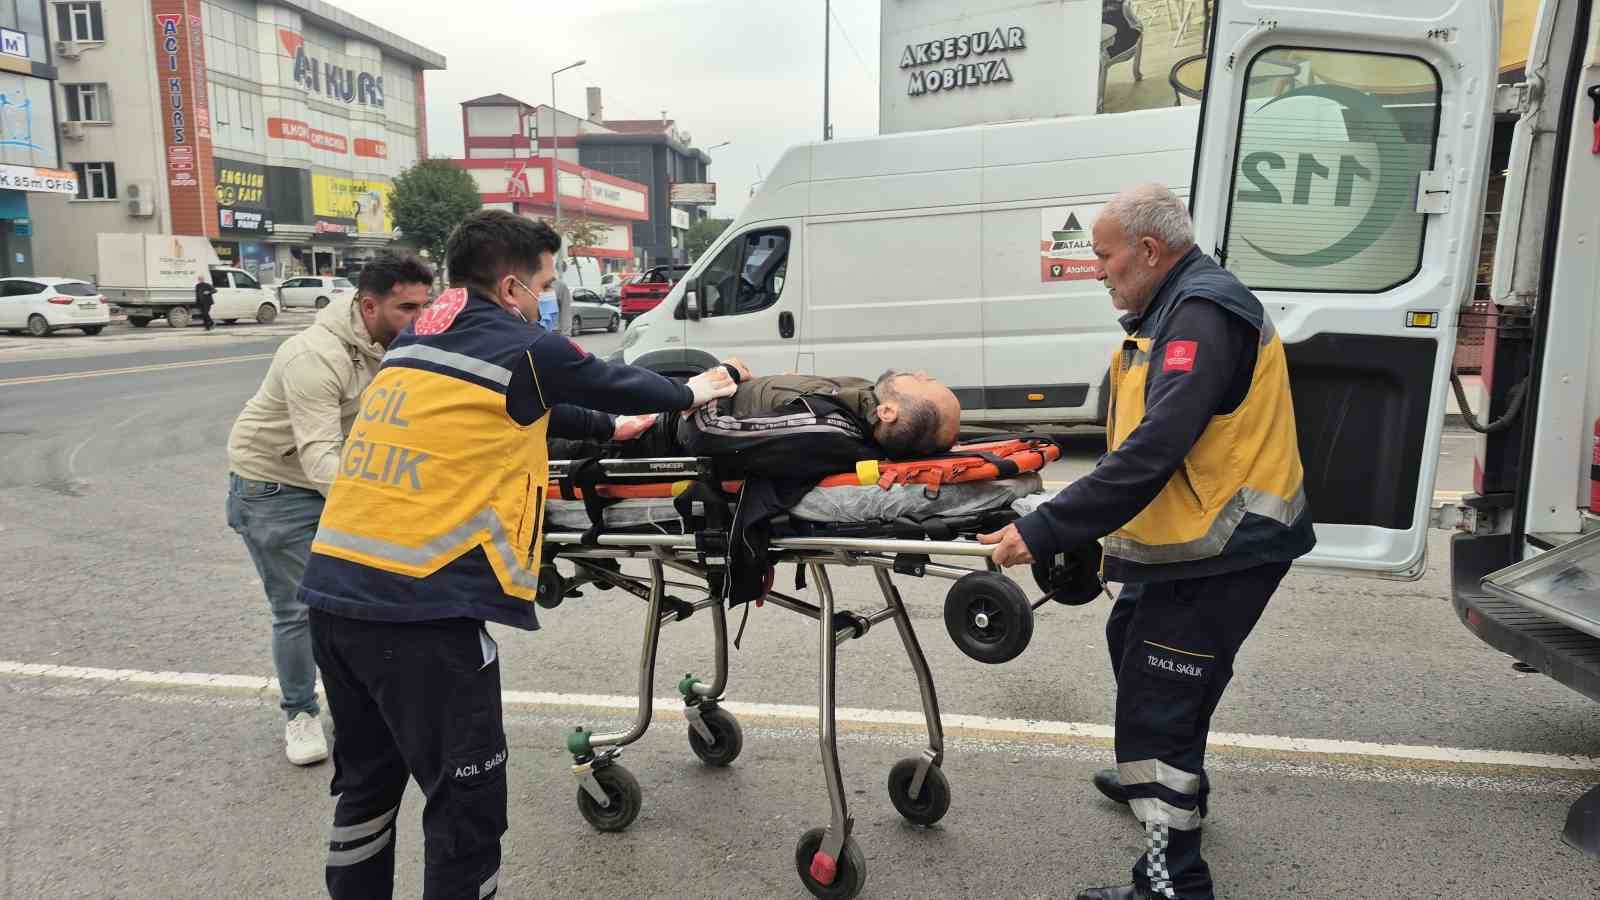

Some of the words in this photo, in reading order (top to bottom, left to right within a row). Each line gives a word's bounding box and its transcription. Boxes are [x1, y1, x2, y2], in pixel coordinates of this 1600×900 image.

[899, 27, 1026, 68] AKSESUAR
[324, 62, 384, 109] KURS
[908, 58, 1013, 96] MOBİLYA
[220, 169, 264, 188] ENGLISH
[238, 187, 262, 202] FAST
[363, 380, 410, 428] CİL
[343, 431, 431, 490] ĞLIK
[455, 763, 480, 777] ACİL
